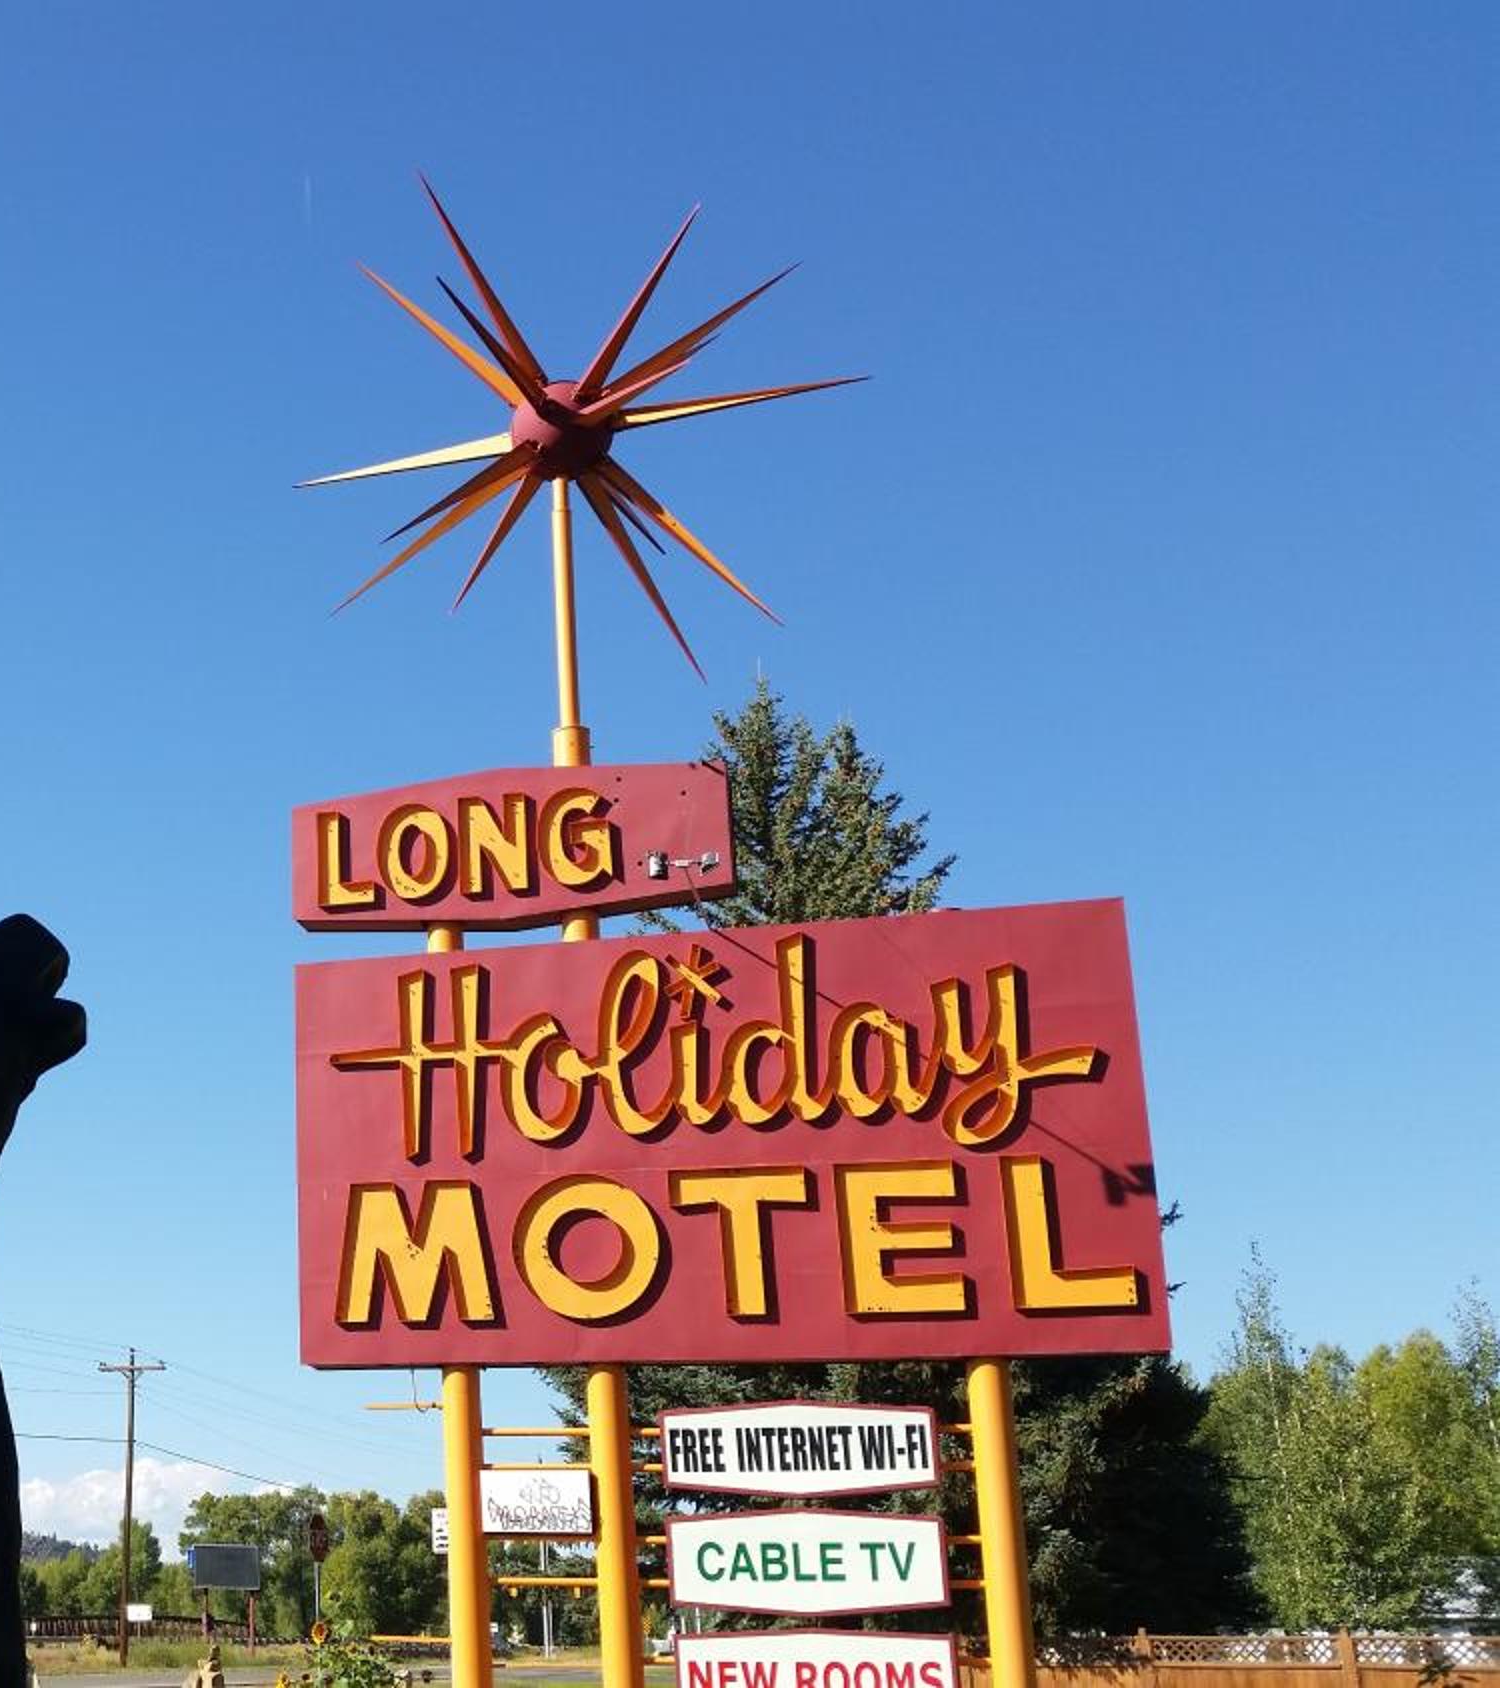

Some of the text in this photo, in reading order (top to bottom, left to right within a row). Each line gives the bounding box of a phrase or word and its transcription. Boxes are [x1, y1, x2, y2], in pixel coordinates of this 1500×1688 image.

[317, 787, 613, 907] LONG
[331, 932, 1100, 1161] Holiday
[336, 1155, 1140, 1327] MOTEL
[668, 1424, 929, 1473] FREE INTERNET WI-FI
[697, 1541, 916, 1582] CABLE TV
[687, 1660, 944, 1688] NEW ROOMS
